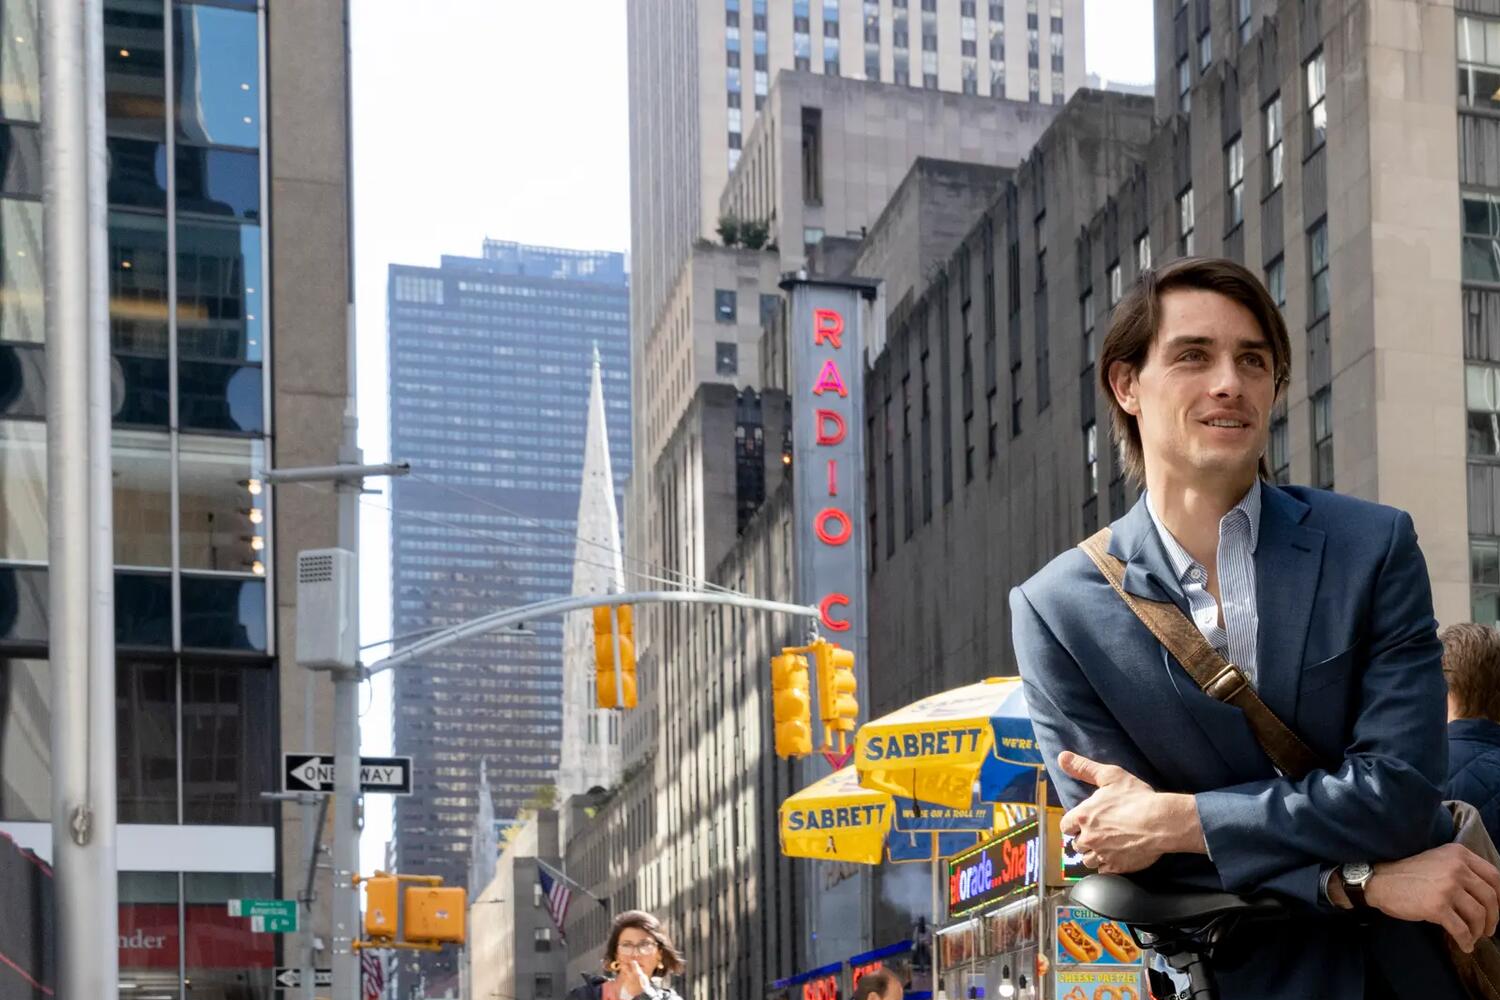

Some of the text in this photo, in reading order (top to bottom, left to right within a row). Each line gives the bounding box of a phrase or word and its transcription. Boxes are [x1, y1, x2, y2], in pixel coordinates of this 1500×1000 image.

[812, 308, 853, 547] RADIO
[865, 728, 983, 761] SABRETT
[787, 803, 886, 832] SABRETT
